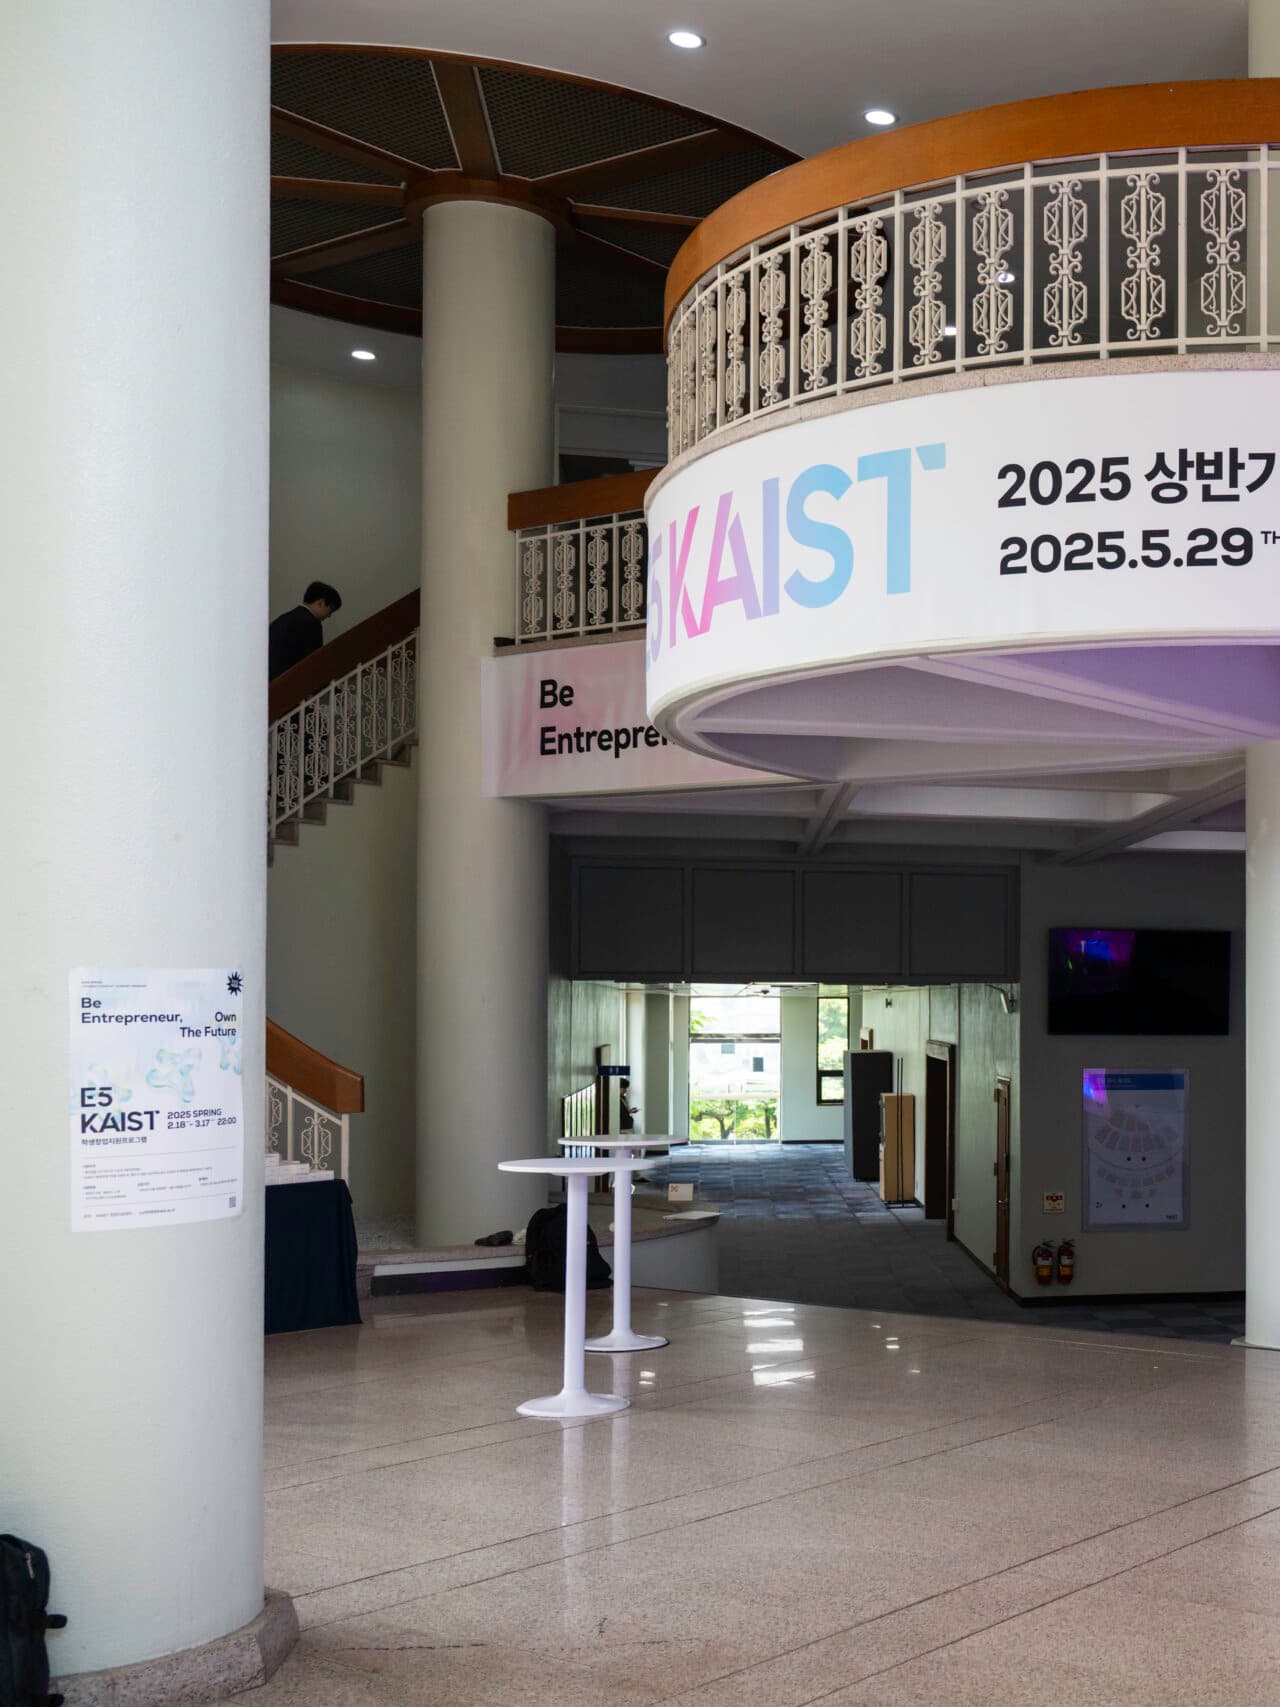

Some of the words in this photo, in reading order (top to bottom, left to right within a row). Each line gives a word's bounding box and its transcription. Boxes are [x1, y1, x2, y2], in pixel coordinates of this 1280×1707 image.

[997, 456, 1131, 508] 2025
[669, 442, 946, 648] KAIST
[999, 526, 1254, 576] 2025.5.29
[540, 679, 575, 709] Be
[540, 724, 672, 759] Entrepre
[81, 997, 102, 1009] Be
[81, 1012, 183, 1026] Entrepreneur,
[215, 1011, 237, 1023] Own
[179, 1026, 203, 1038] The
[204, 1025, 237, 1037] Future
[80, 1086, 113, 1108] E5
[81, 1110, 160, 1135] KAIST
[167, 1110, 192, 1120] 2025
[193, 1108, 222, 1119] SPRING
